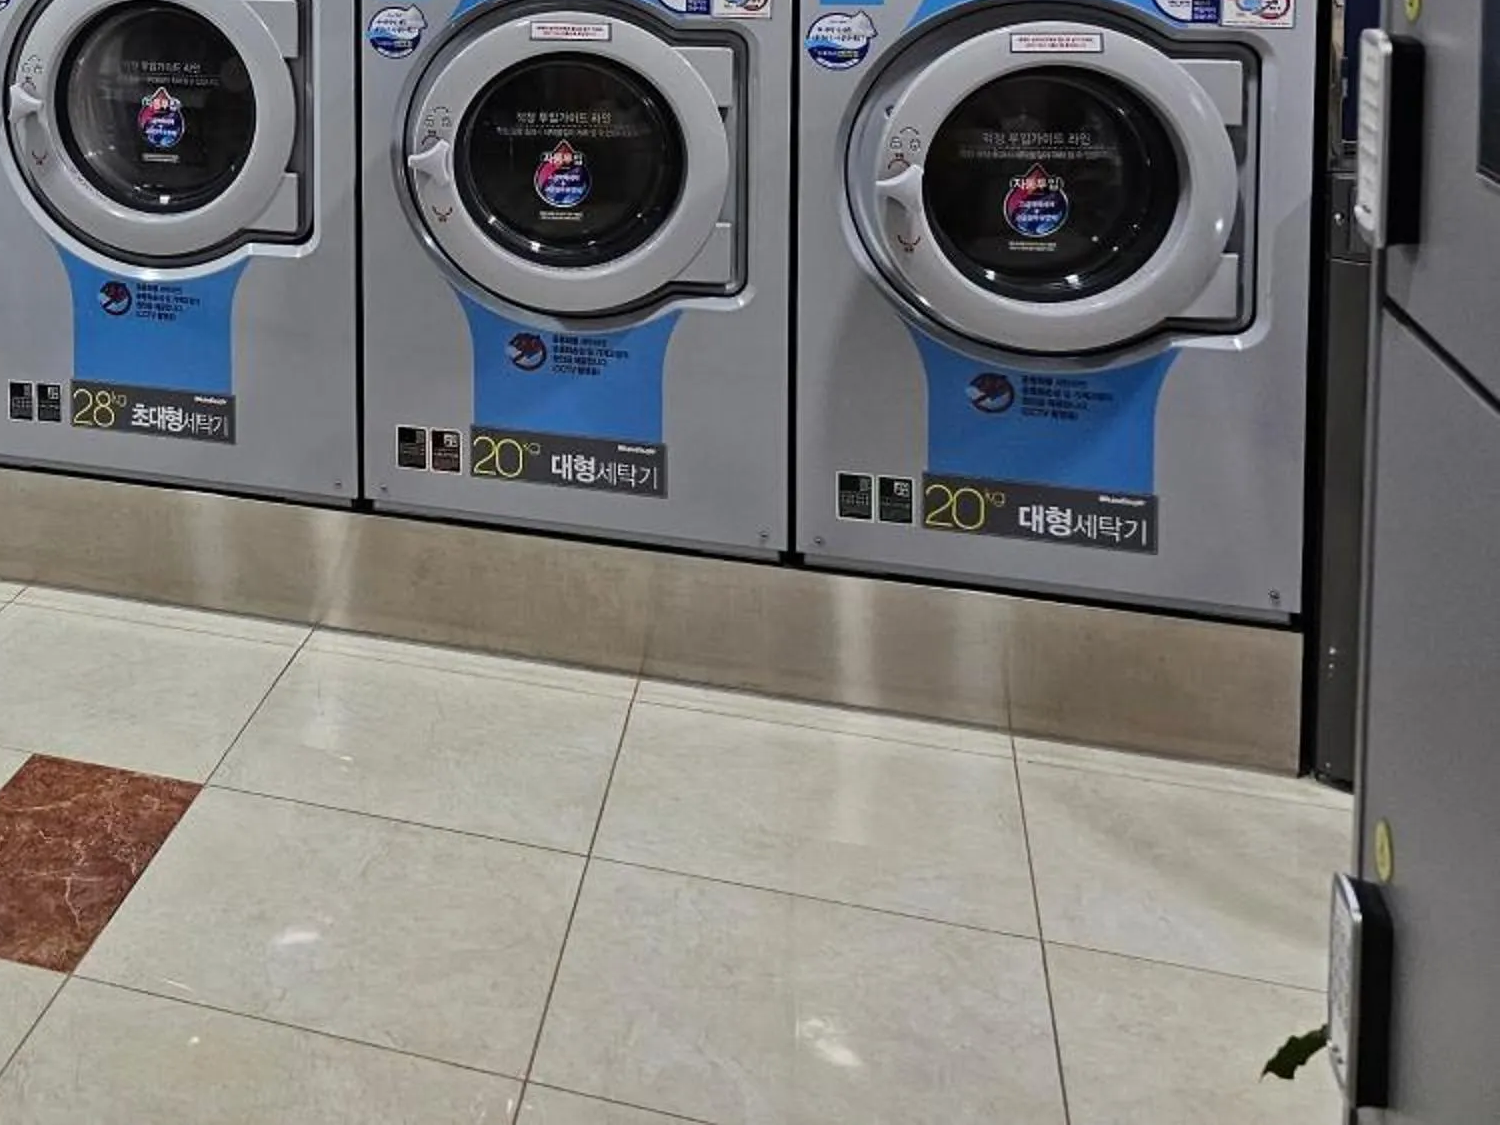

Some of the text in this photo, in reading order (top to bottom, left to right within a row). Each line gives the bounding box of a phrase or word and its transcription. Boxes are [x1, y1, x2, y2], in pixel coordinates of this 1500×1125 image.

[131, 403, 229, 437] 초대형세탁기
[551, 453, 658, 490] 대형세탁기
[1018, 504, 1148, 546] 대형세탁기
